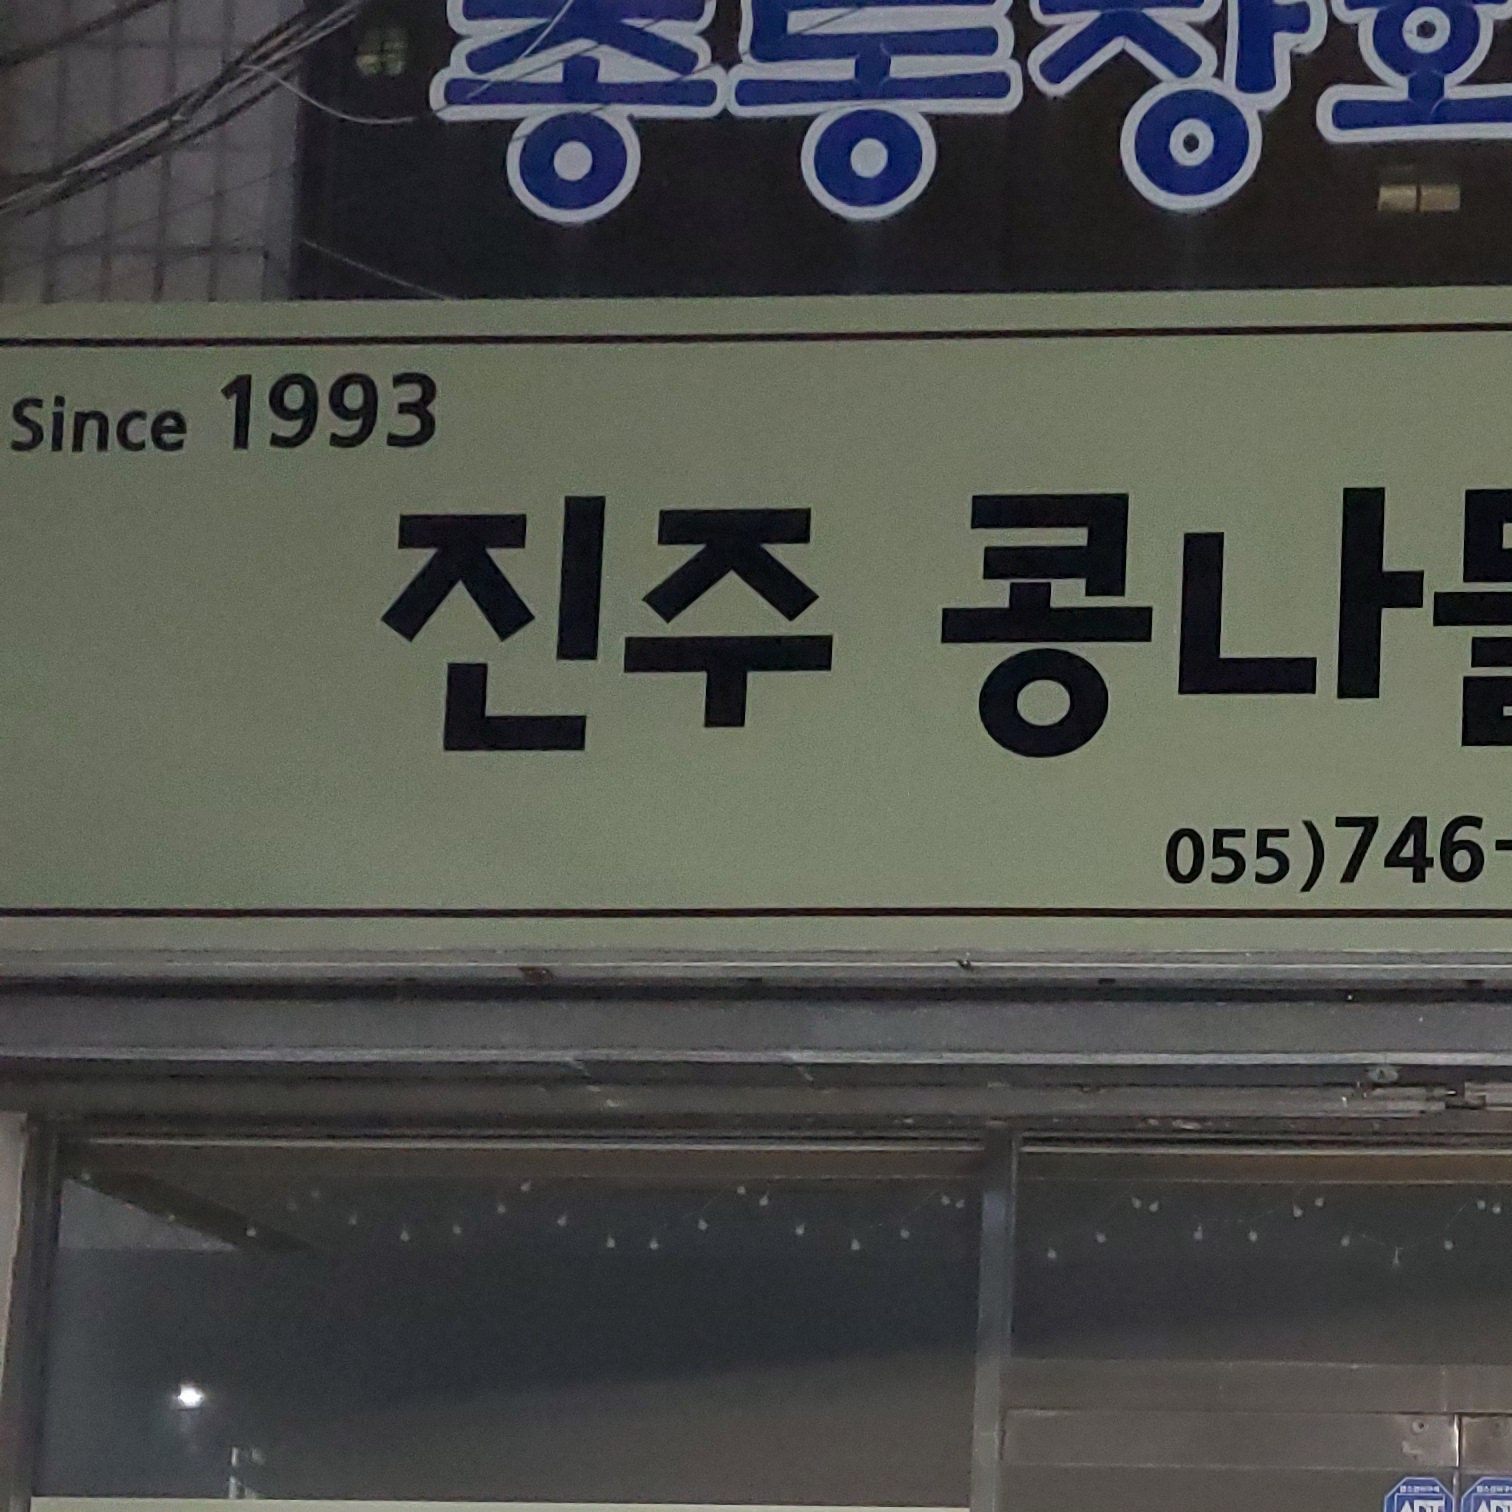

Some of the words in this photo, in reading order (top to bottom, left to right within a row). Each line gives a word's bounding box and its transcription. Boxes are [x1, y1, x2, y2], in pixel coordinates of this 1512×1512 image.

[10, 394, 187, 453] Since
[220, 372, 437, 450] 1993
[380, 495, 834, 752] 진주
